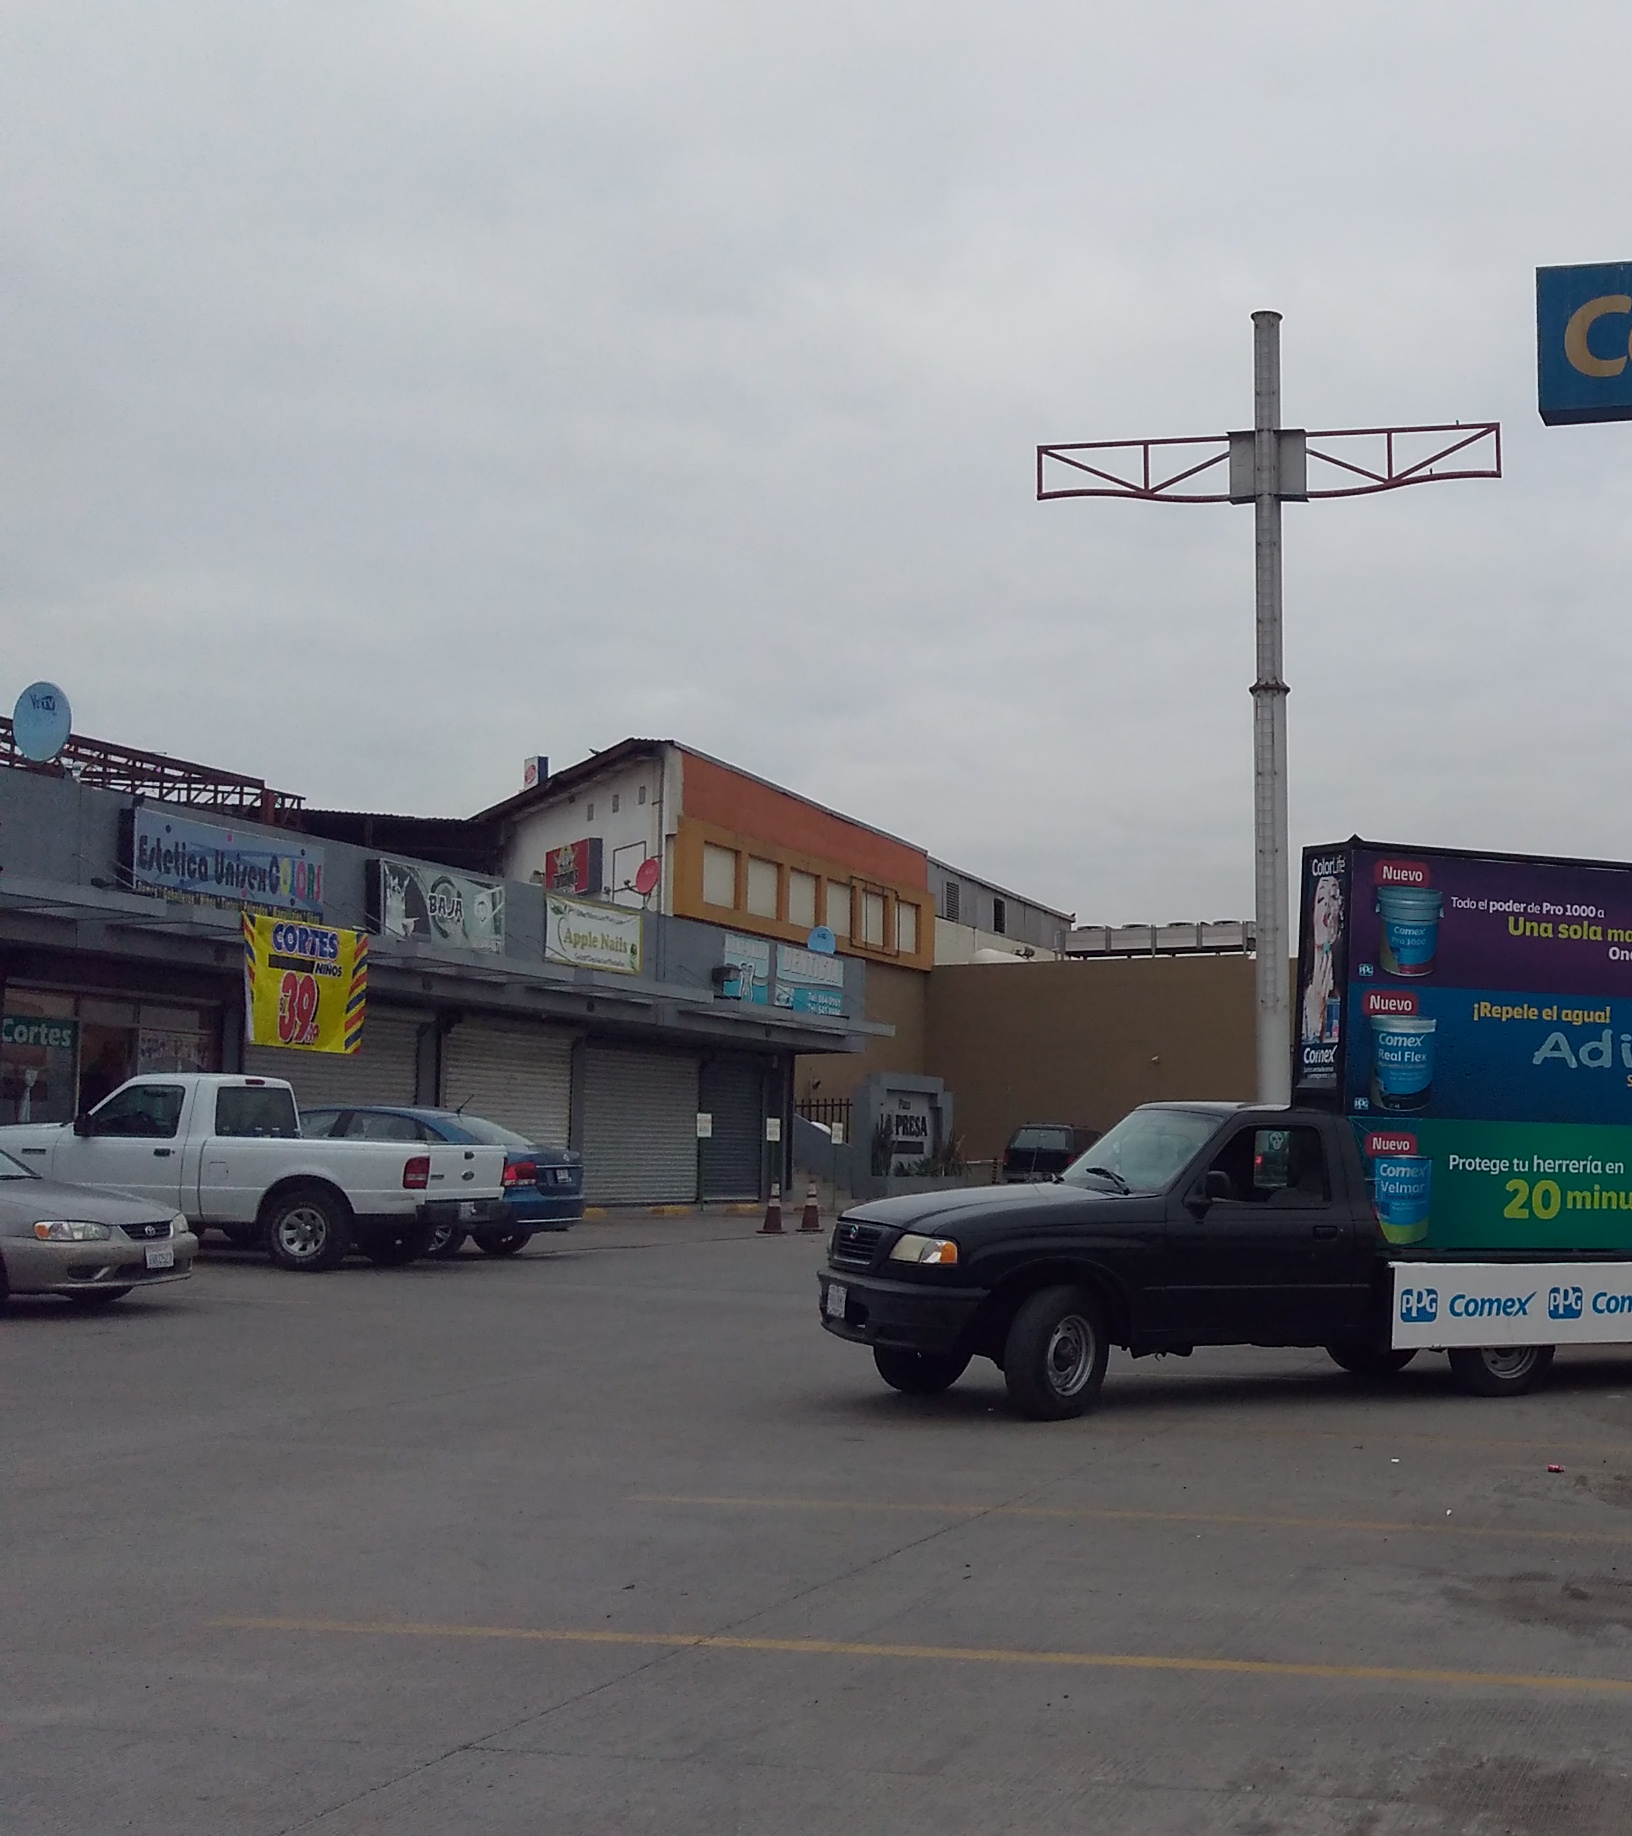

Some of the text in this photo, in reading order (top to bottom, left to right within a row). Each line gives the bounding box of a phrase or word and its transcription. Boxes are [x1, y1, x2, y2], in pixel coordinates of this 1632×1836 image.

[1312, 855, 1346, 876] ColorLife
[1382, 865, 1424, 882] Nuevo
[428, 893, 464, 920] BAJA
[1451, 896, 1605, 919] Todo el poder de Pro 1000 a
[1508, 916, 1553, 938] Una
[1558, 920, 1603, 941] sola
[272, 922, 340, 961] CORTES
[563, 926, 628, 954] Apple Nails
[315, 963, 342, 977] NIÑOS
[1369, 994, 1413, 1012] Nuevo
[1473, 1002, 1611, 1025] ¡Repele el agua!
[2, 1018, 72, 1046] Cortes
[1378, 1033, 1426, 1047] Comex
[1303, 1044, 1338, 1065] Comex
[1378, 1049, 1427, 1063] Real Flex
[895, 1114, 928, 1137] PRESA
[1372, 1136, 1411, 1151] Nuevo
[1380, 1163, 1428, 1178] Comex
[1449, 1154, 1625, 1175] Protege tu herrería en
[1380, 1180, 1426, 1194] Velmar
[1503, 1178, 1562, 1220] 20
[1401, 1288, 1437, 1319] PPG
[1448, 1291, 1539, 1318] Comex
[1549, 1286, 1583, 1317] PPG
